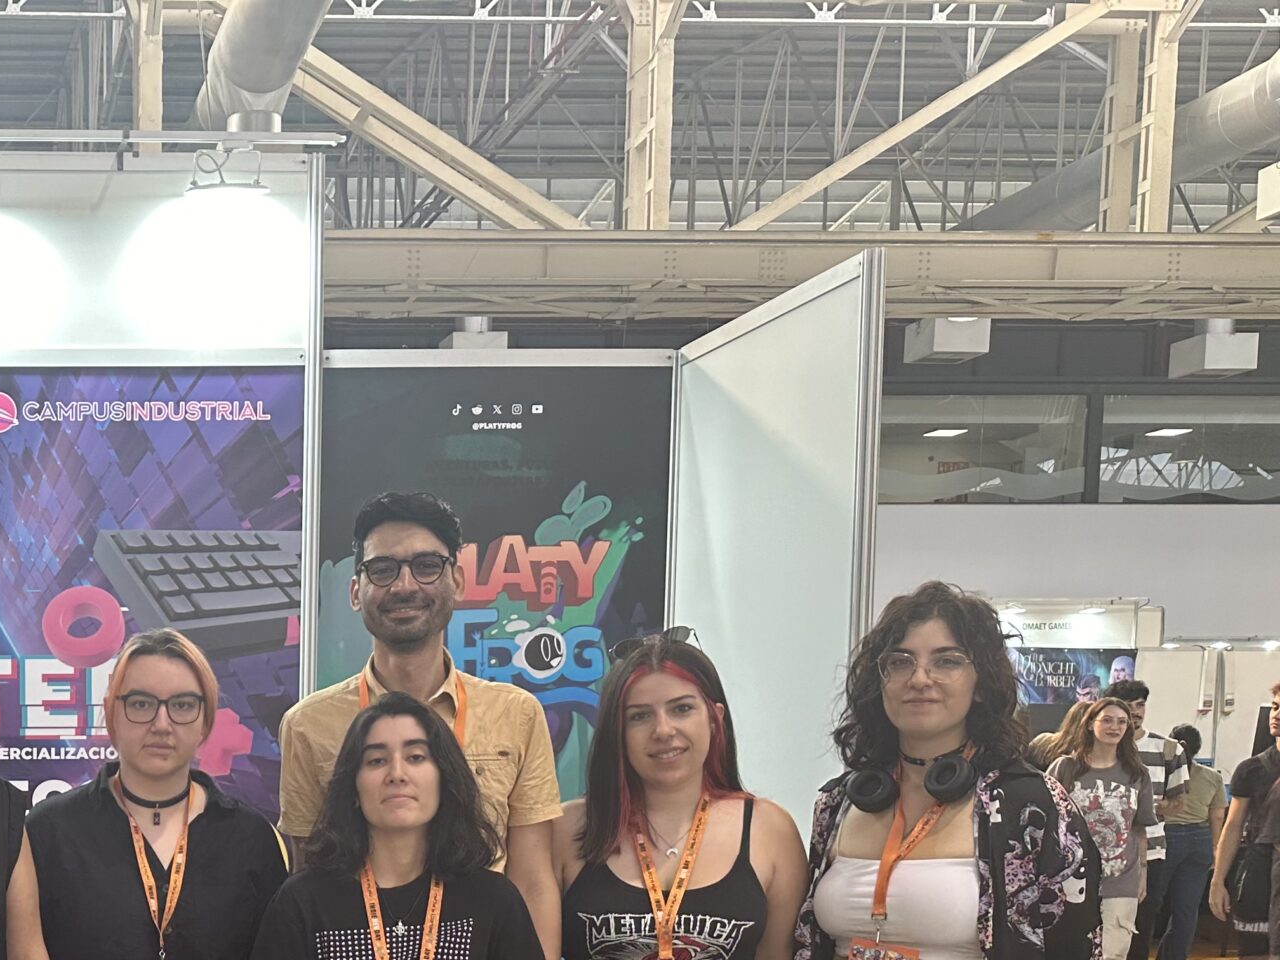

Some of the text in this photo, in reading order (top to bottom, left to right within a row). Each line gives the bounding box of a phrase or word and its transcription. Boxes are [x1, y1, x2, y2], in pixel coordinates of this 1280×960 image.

[22, 400, 271, 422] CAMPUSINDUSTRIAL
[472, 422, 522, 430] @PLATYFROG
[456, 535, 611, 604] LATY
[1022, 622, 1072, 630] OMAET GAMES
